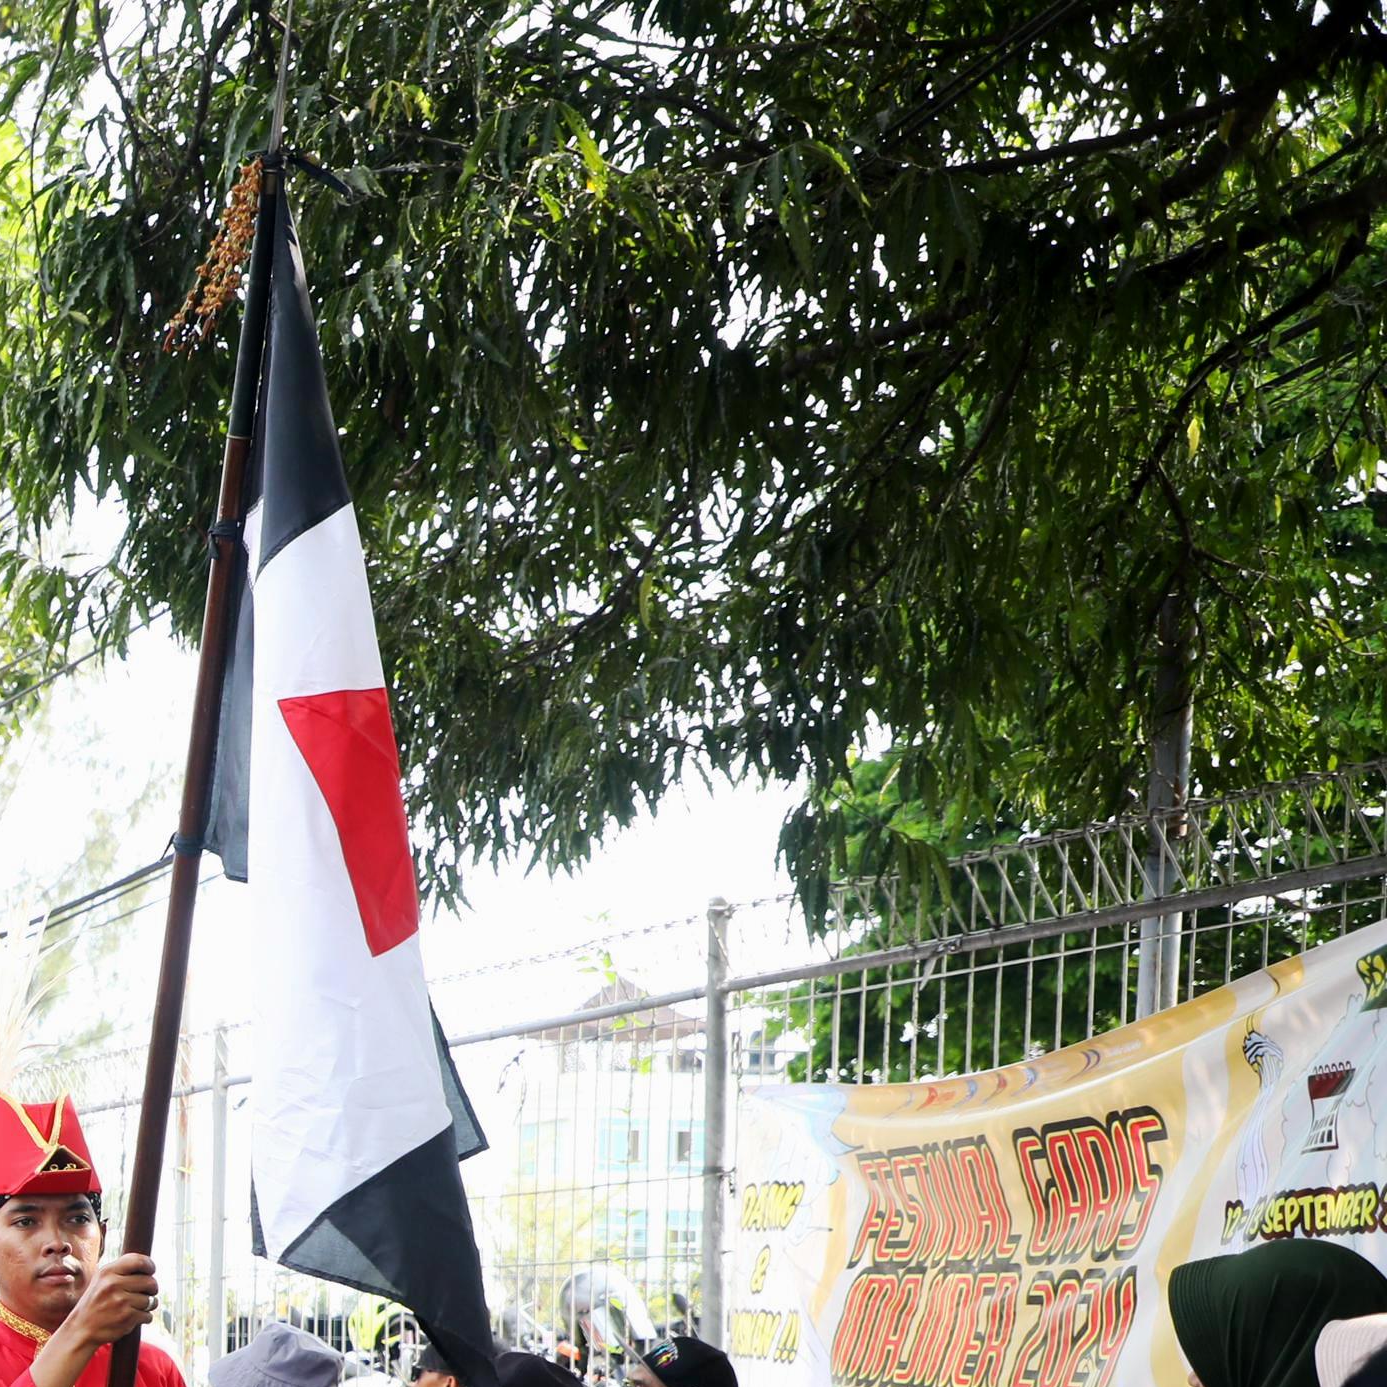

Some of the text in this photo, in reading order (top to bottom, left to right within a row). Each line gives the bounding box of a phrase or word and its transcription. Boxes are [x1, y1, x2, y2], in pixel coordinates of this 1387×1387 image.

[848, 1109, 1166, 1266] FESTIVAL GARIS
[1261, 1187, 1377, 1235] SEPTEMBER
